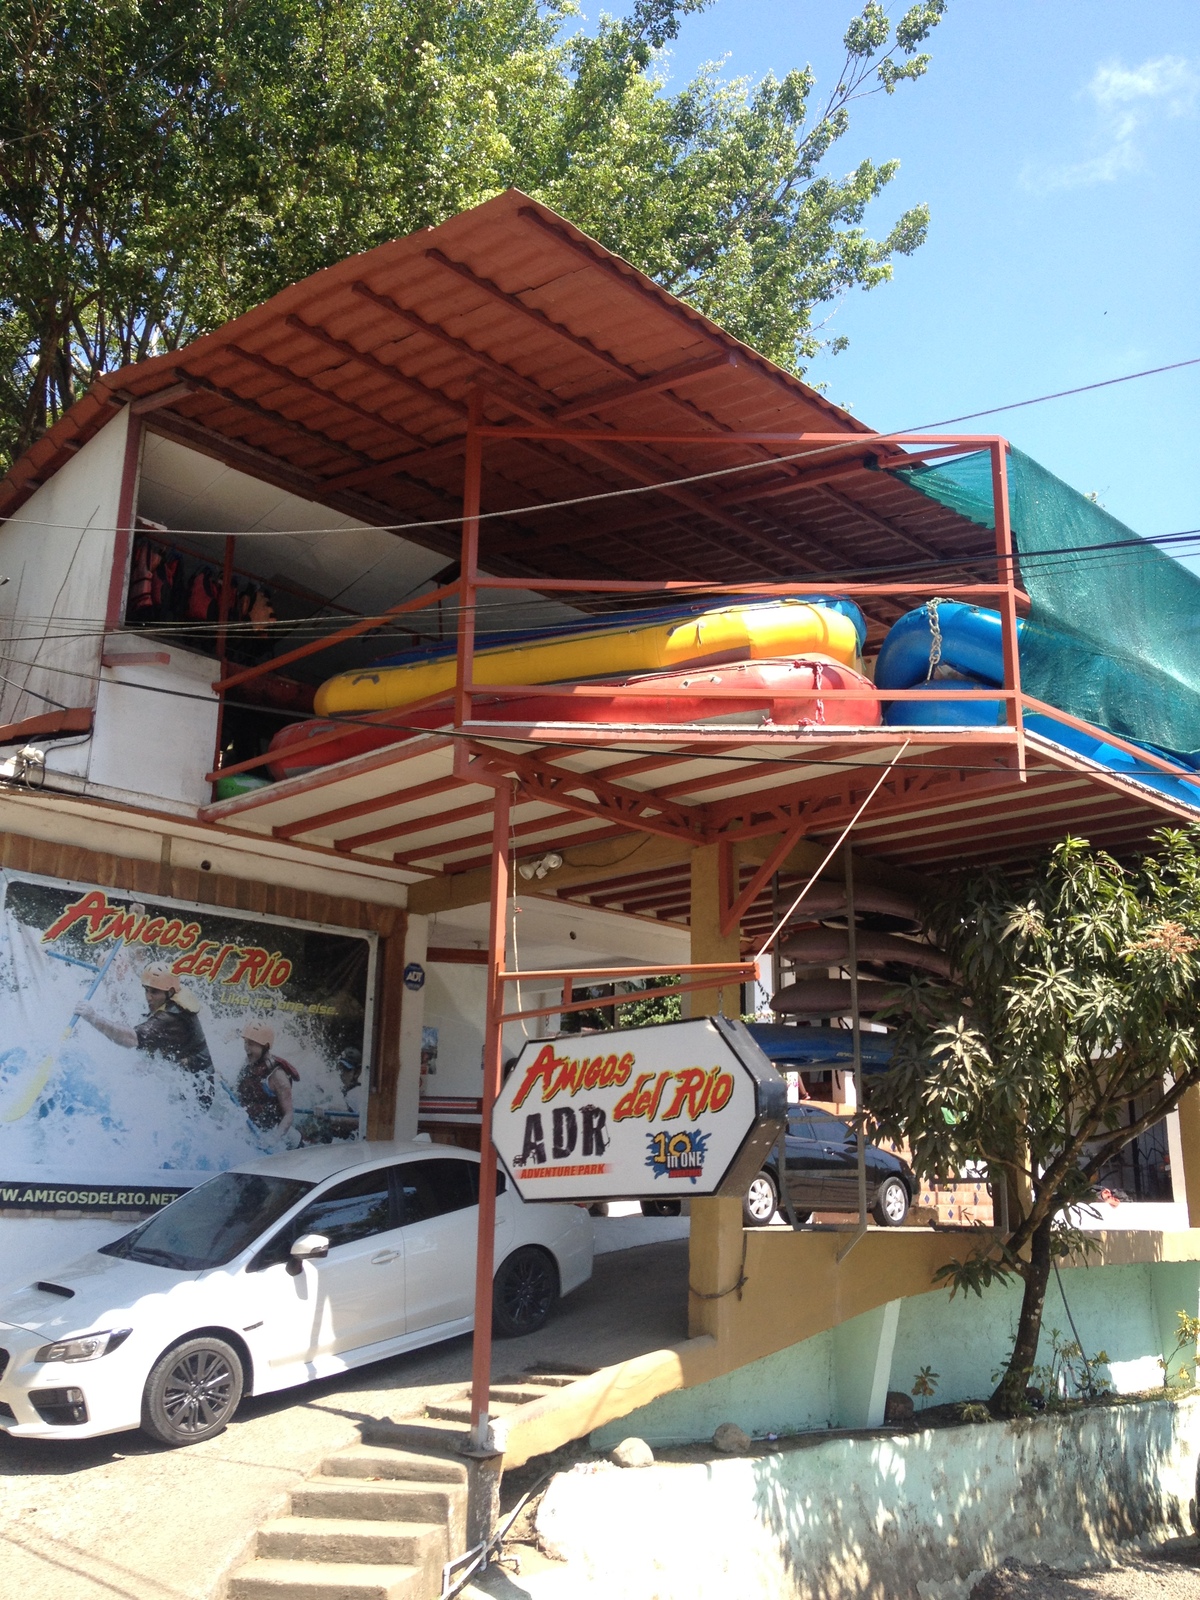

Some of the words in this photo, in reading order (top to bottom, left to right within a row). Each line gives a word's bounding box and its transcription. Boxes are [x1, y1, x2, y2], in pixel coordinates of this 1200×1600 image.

[171, 940, 219, 983] del
[406, 971, 423, 982] ADT
[221, 992, 249, 1006] Like
[276, 1000, 304, 1012] one
[613, 1072, 668, 1122] del
[517, 1105, 607, 1165] ADR
[653, 1131, 692, 1163] 10
[667, 1153, 678, 1168] in
[681, 1152, 702, 1167] ONE
[521, 1167, 578, 1179] ADVENTURE
[579, 1163, 606, 1175] PARK
[0, 1188, 178, 1206] W.AMIGOSDELRIO.NET
